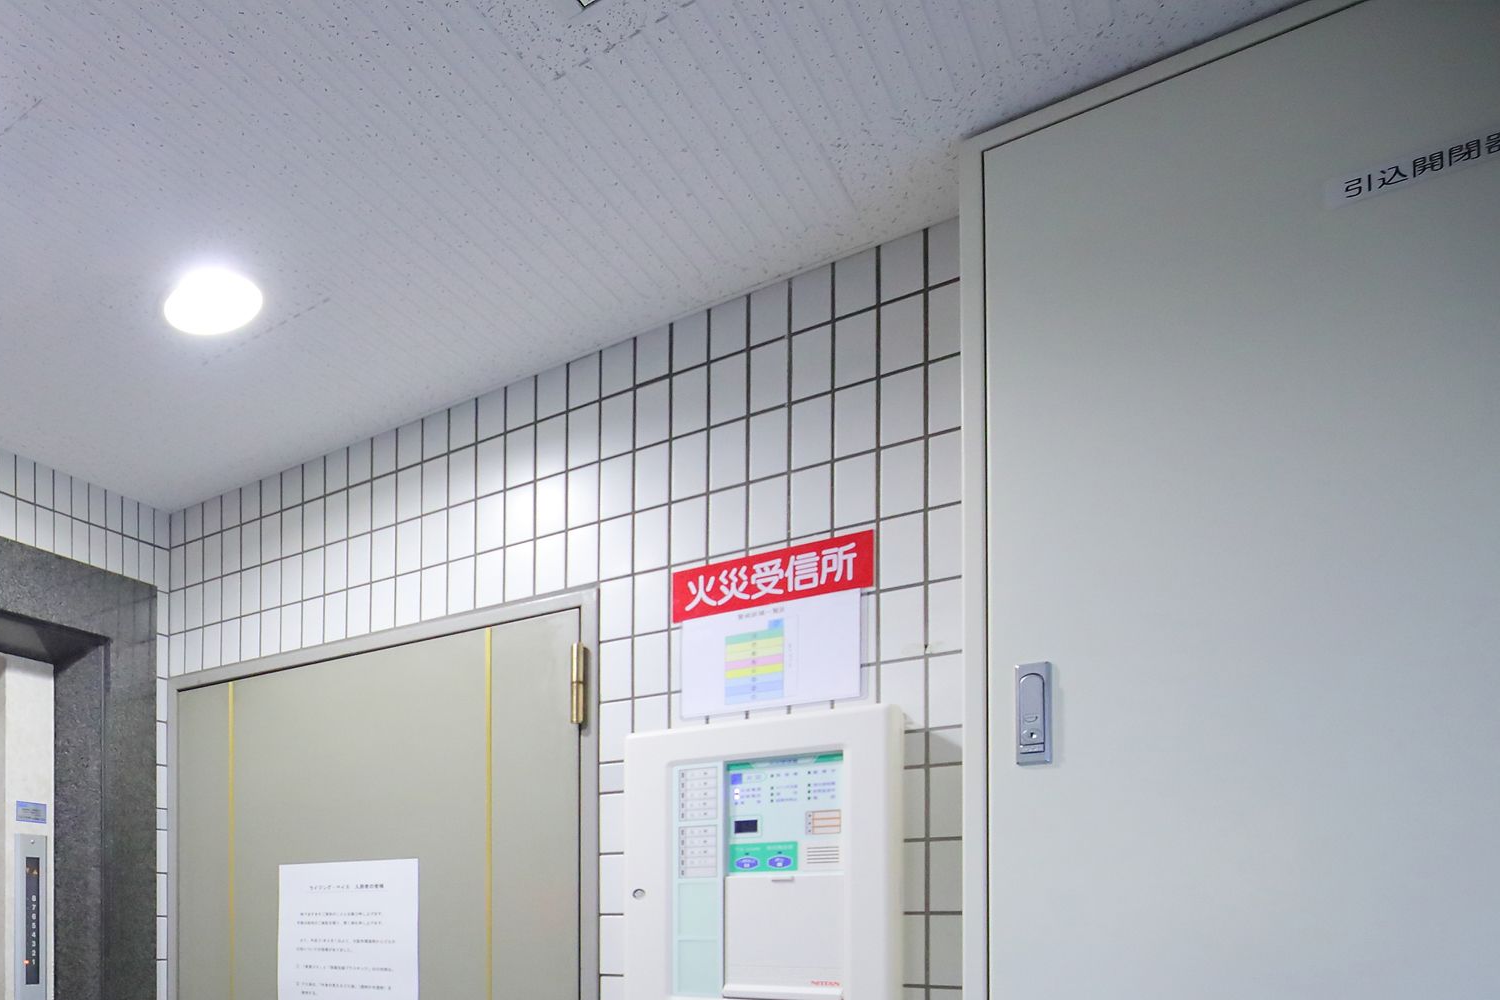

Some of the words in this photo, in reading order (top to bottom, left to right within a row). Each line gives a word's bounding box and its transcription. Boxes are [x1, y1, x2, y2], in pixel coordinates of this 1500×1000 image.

[684, 542, 857, 612] 火災受信所
[31, 949, 37, 957] 2
